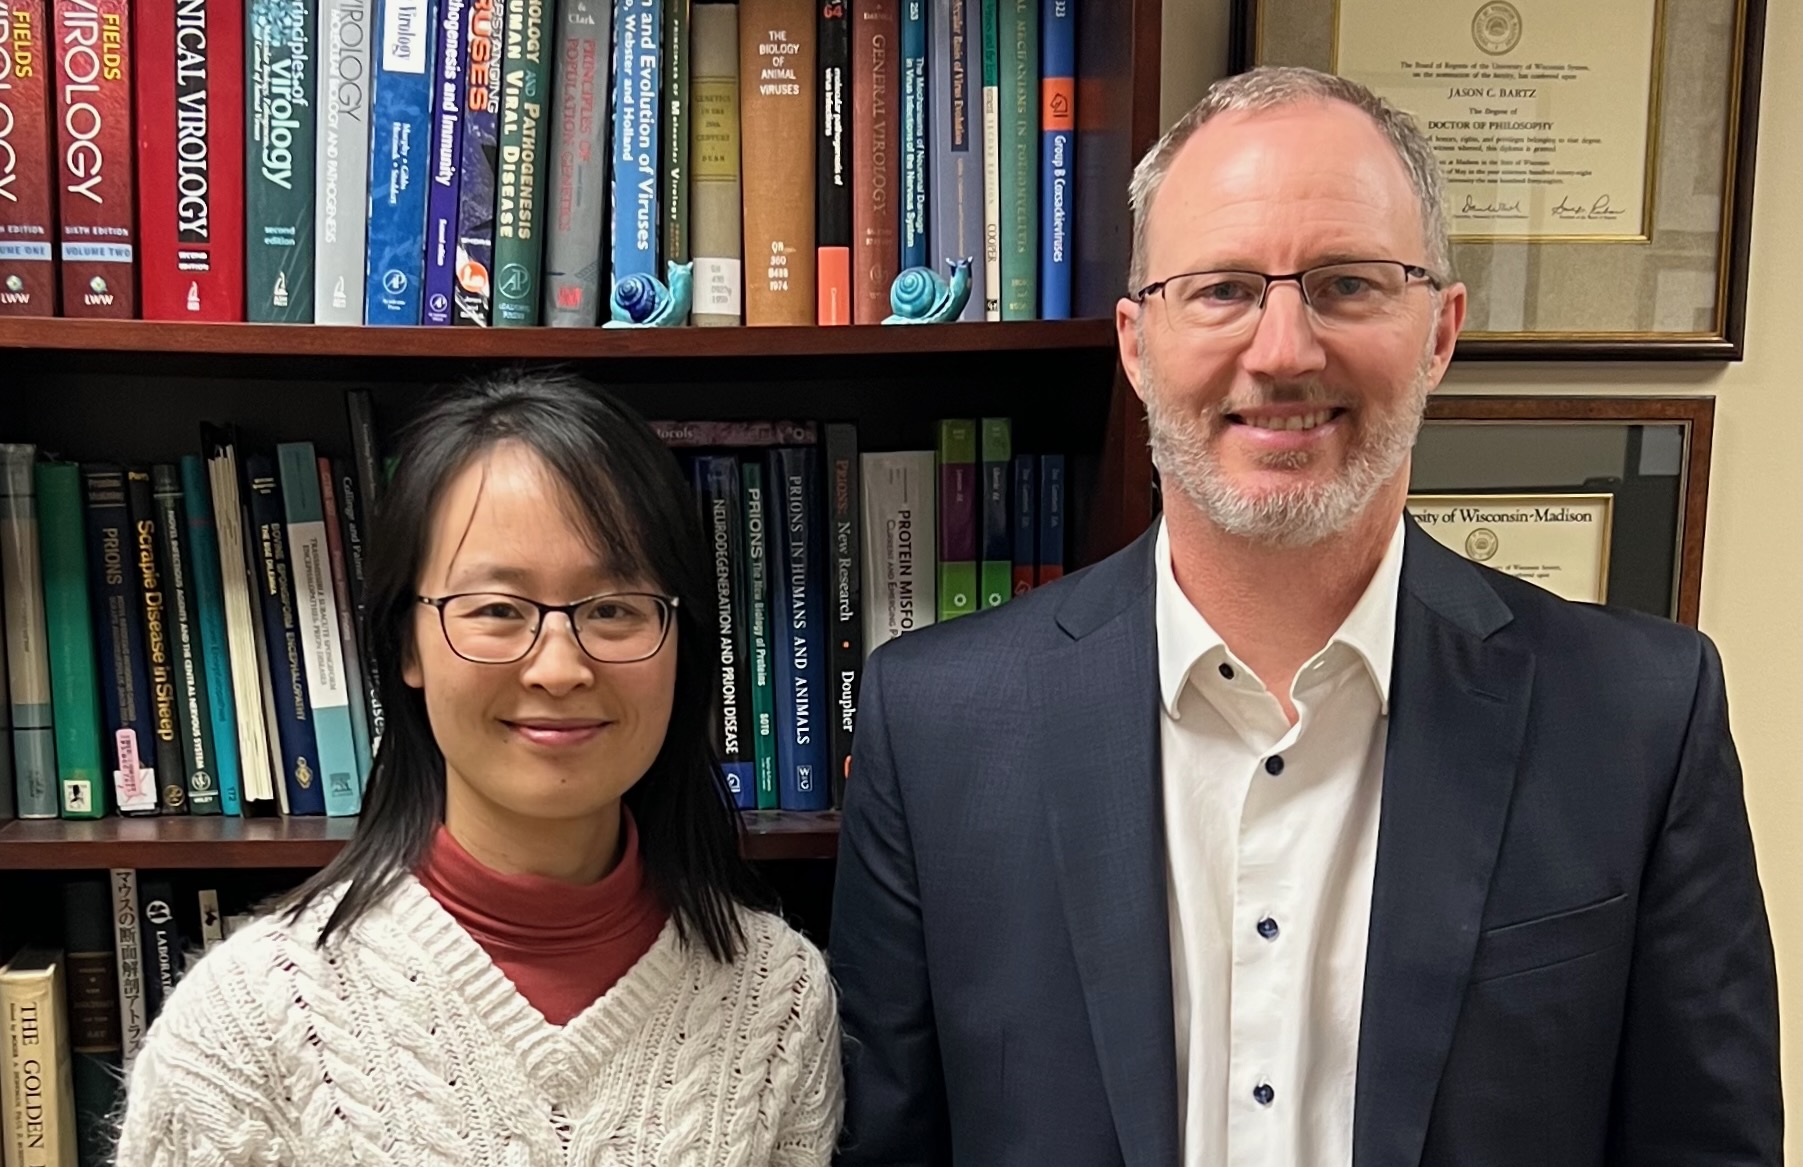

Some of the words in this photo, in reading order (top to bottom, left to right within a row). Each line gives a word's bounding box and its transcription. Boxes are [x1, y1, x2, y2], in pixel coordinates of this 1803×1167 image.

[567, 14, 597, 25] Clark
[910, 2, 919, 21] 253
[1055, 1, 1066, 18] 323
[12, 9, 33, 78] FIELDS
[102, 13, 122, 81] FIELDS
[329, 9, 341, 76] MOLECULAR
[392, 6, 418, 60] Virology
[507, 0, 524, 59] UMAN
[623, 14, 637, 76] Webster
[640, 13, 657, 49] and
[769, 31, 787, 42] THE
[338, 0, 363, 122] IROLOGY
[672, 19, 680, 79] PRINCIPLES
[759, 44, 800, 55] BIOLOGY
[772, 57, 785, 68] OF
[906, 58, 914, 68] in
[916, 56, 925, 76] The
[525, 71, 537, 98] AND
[563, 37, 581, 146] POPULATION
[580, 38, 597, 133] PRINCIPLES
[623, 79, 635, 106] and
[760, 84, 800, 96] VIRUSES
[761, 69, 796, 80] ANIMAL
[833, 67, 843, 114] molecular
[872, 34, 887, 118] GENERAL
[906, 69, 914, 94] Virus
[953, 74, 964, 99] Virus
[328, 78, 340, 129] BIOLOGY
[442, 82, 459, 112] and
[504, 70, 524, 135] VIRAL
[639, 55, 656, 149] Evolution
[916, 77, 924, 137] Mechanisms
[1448, 88, 1484, 99] JASON
[1486, 88, 1497, 98] C.
[1499, 88, 1537, 98] BARTZ
[1469, 107, 1482, 116] The
[262, 58, 300, 190] virology
[622, 107, 635, 162] Holland
[671, 100, 681, 164] Molecular
[906, 96, 914, 141] Infections
[953, 100, 965, 146] Evolution
[1017, 120, 1027, 137] IN
[1428, 121, 1471, 130] DOCTOR
[1473, 121, 1487, 130] OF
[1489, 121, 1554, 131] PHILOSOPHY
[326, 131, 338, 158] AND
[434, 114, 458, 187] Immunity
[579, 139, 592, 162] OF
[906, 142, 914, 152] of
[906, 153, 915, 170] the
[916, 138, 925, 149] of
[1053, 134, 1067, 168] Group
[178, 89, 208, 238] VIROLOGY
[518, 103, 541, 240] PATHOGENESIS
[638, 153, 655, 176] of
[834, 174, 844, 186] of
[872, 120, 887, 215] VIROLOGY
[917, 150, 925, 193] Neuronal
[1054, 168, 1066, 177] B
[324, 160, 338, 243] PATHOGENESIS
[500, 146, 521, 238] DISEASE
[558, 152, 574, 233] GENETICS
[670, 167, 681, 221] Virology
[906, 170, 915, 211] Nervous
[92, 227, 129, 236] EDITION
[637, 178, 654, 251] Viruses
[904, 212, 915, 248] System
[914, 194, 925, 234] Damage
[1053, 178, 1066, 263] Coxsackieviruses
[66, 246, 105, 257] VOLUME
[109, 248, 131, 258] TWO
[771, 255, 786, 265] 360
[987, 223, 998, 262] COOPER
[1, 293, 30, 304] LWW
[84, 294, 114, 305] LWW
[769, 280, 789, 291] 1974
[343, 477, 356, 520] Collinge
[789, 476, 803, 532] PRIONS
[1442, 508, 1456, 523] of
[1460, 507, 1592, 523] Wisconsin-Madison
[168, 511, 178, 538] NOVEL
[261, 525, 270, 540] THE
[271, 523, 284, 560] BOVINE
[350, 523, 360, 542] and
[748, 488, 762, 559] PRIONS
[837, 522, 850, 554] New
[103, 528, 122, 584] PRIONS
[138, 520, 160, 588] Scrapie
[264, 542, 273, 557] BSE
[791, 542, 804, 558] IN
[898, 510, 912, 576] PROTEIN
[171, 540, 183, 587] INFECTIOUS
[265, 559, 277, 595] DILEMMA
[352, 545, 364, 580] Palmer
[712, 500, 732, 634] NEURODEGENERATION
[752, 562, 762, 578] The
[887, 562, 895, 580] AND
[176, 589, 187, 621] AGENTS
[276, 563, 293, 629] SPONGIFORM
[792, 564, 806, 629] HUMANS
[838, 558, 853, 622] Research
[145, 592, 165, 662] Disease
[180, 623, 190, 642] AND
[753, 602, 764, 636] Biology
[183, 644, 192, 658] THE
[720, 638, 734, 664] AND
[756, 638, 765, 648] of
[793, 636, 807, 669] AND
[154, 666, 170, 682] in
[184, 660, 197, 696] CENTRAL
[286, 632, 306, 720] ENCEPHALOPATHY
[756, 649, 766, 686] Proteins
[721, 667, 735, 705] PRION
[838, 671, 856, 733] Doupher
[156, 684, 175, 740] Sheep
[188, 698, 201, 737] NERVOUS
[760, 713, 769, 735] SOTO
[794, 677, 809, 745] ANIMALS
[723, 708, 738, 754] DISEASE
[194, 738, 204, 769] SYSTEM
[21, 1002, 39, 1046] THE
[24, 1060, 44, 1149] GOLDEN
